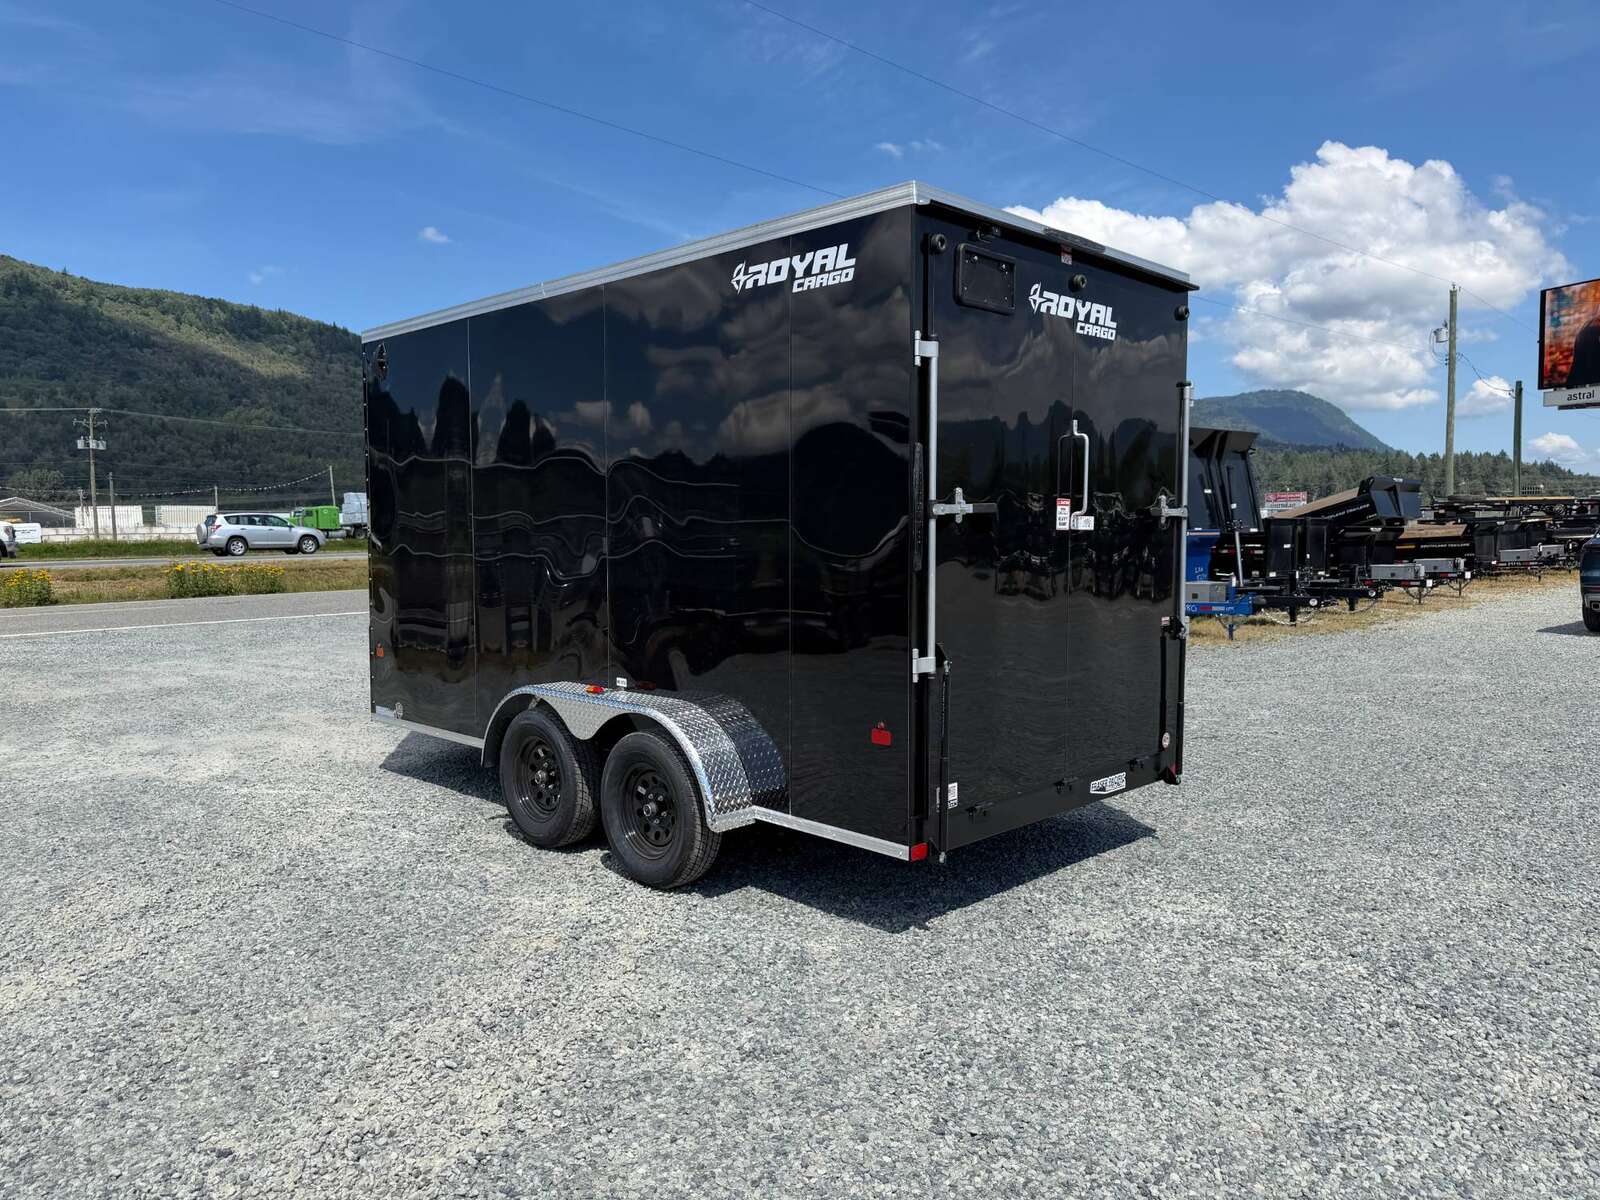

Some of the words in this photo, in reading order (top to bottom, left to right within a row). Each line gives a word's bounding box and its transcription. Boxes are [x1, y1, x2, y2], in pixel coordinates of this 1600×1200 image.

[745, 243, 857, 290] ROYAL
[792, 267, 855, 293] CARGO
[1040, 290, 1117, 329] ROYAL
[1076, 321, 1116, 341] CARGO
[1566, 389, 1595, 401] astral
